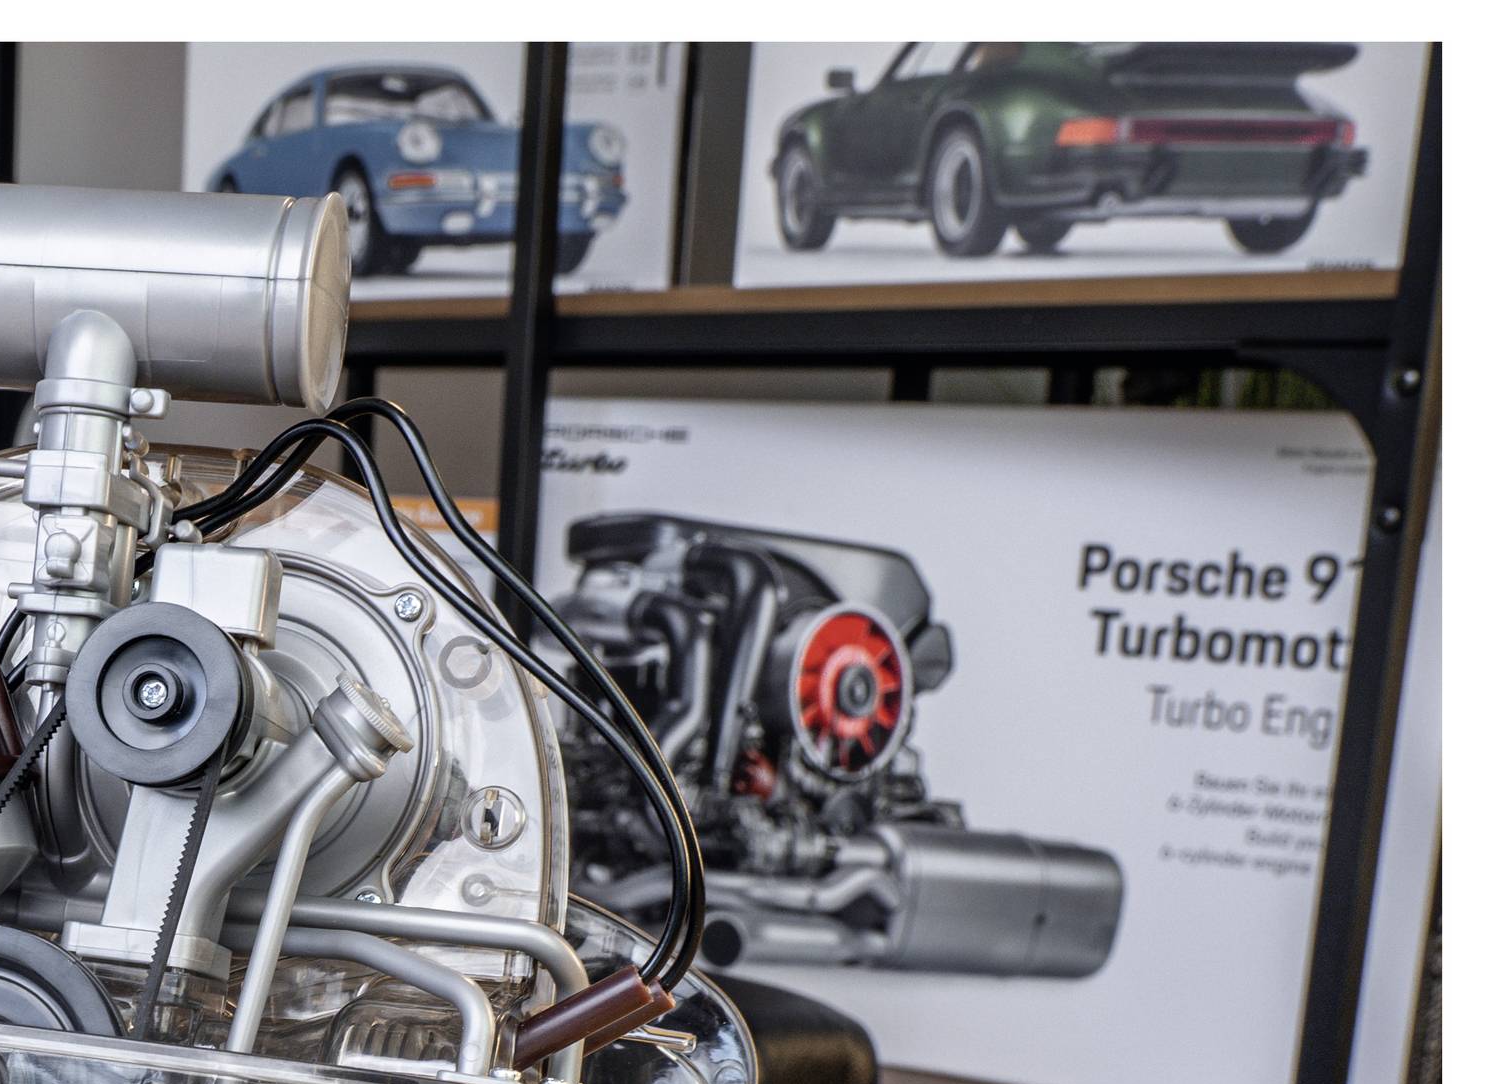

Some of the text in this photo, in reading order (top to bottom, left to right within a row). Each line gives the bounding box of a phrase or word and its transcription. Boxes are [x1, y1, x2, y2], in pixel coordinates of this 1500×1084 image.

[1077, 543, 1363, 603] Porsche 9
[1145, 683, 1335, 751] Turbo Eng
